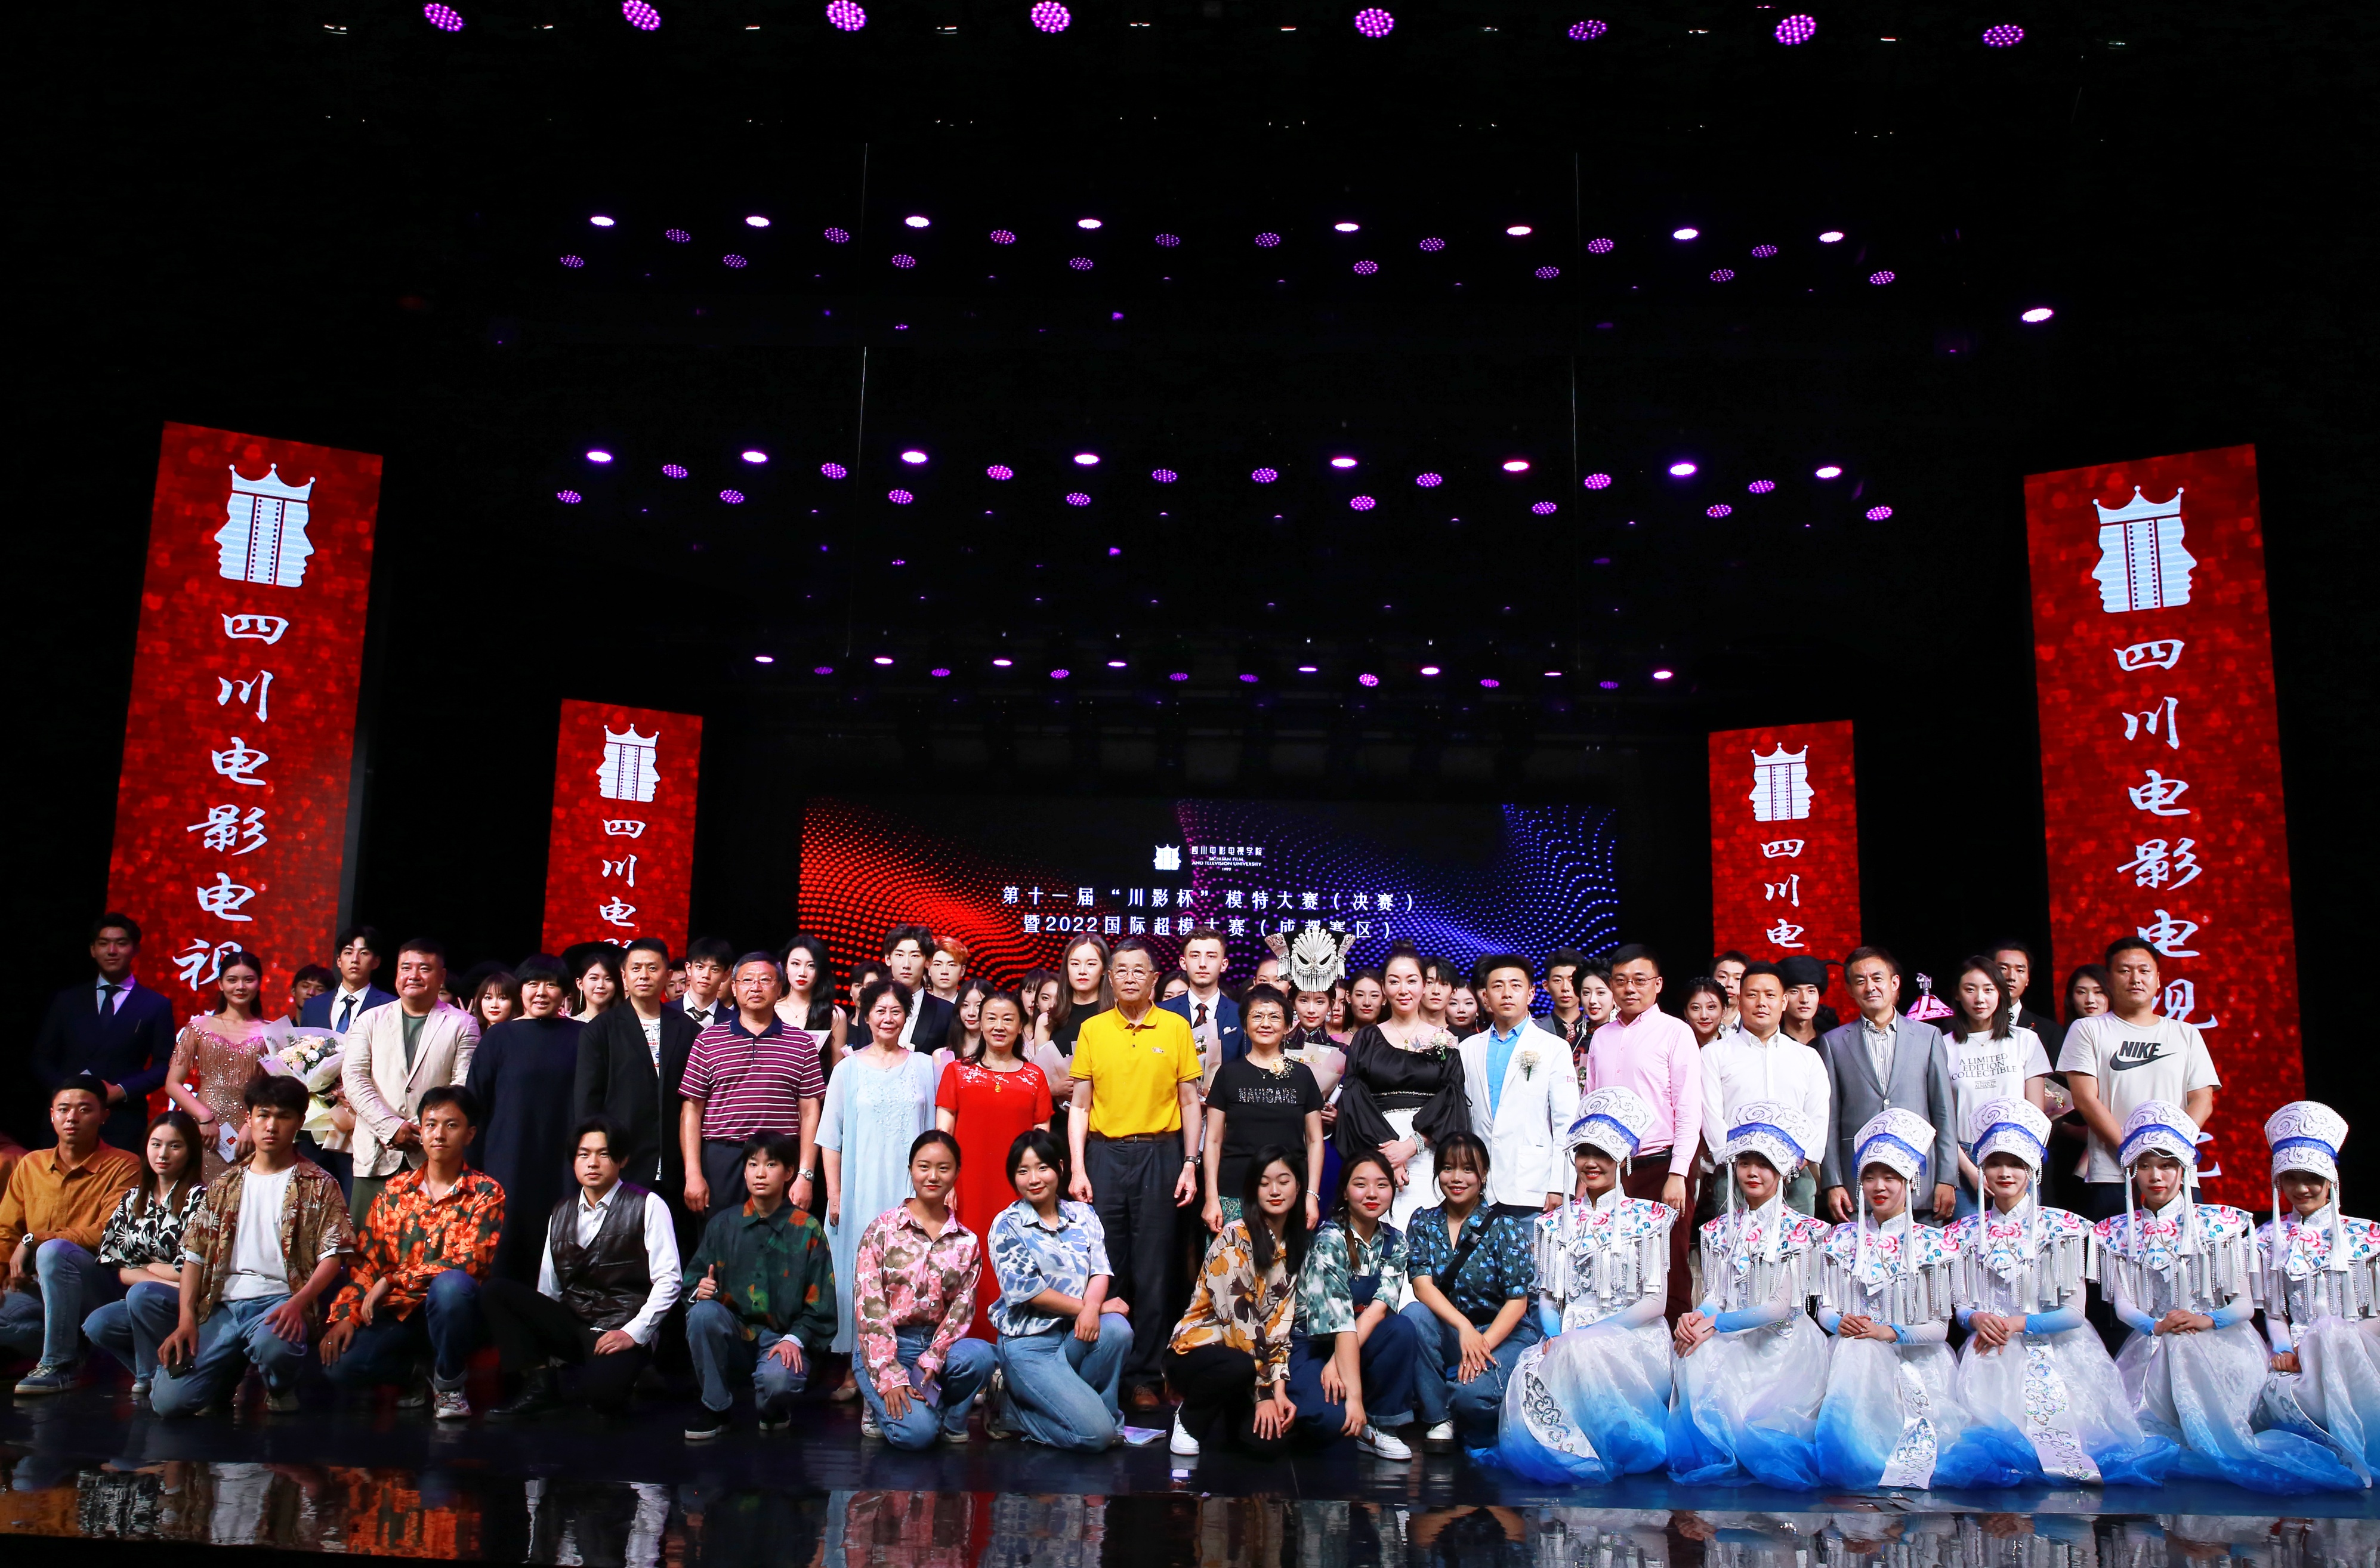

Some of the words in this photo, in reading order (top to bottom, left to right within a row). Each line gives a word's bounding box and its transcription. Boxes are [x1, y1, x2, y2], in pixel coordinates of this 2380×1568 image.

[1191, 845, 1262, 856] 四川电影电视学院
[168, 613, 289, 1112] 四川电影电视
[599, 819, 646, 949] 四川电
[1760, 839, 1805, 948] 四川电
[2119, 1041, 2161, 1059] NIKE
[1963, 1060, 2005, 1072] EDITION
[1968, 1052, 2008, 1065] LIMITED
[1951, 1066, 2017, 1081] COLLECTIBLE
[1239, 1088, 1297, 1104] NAVIGARE
